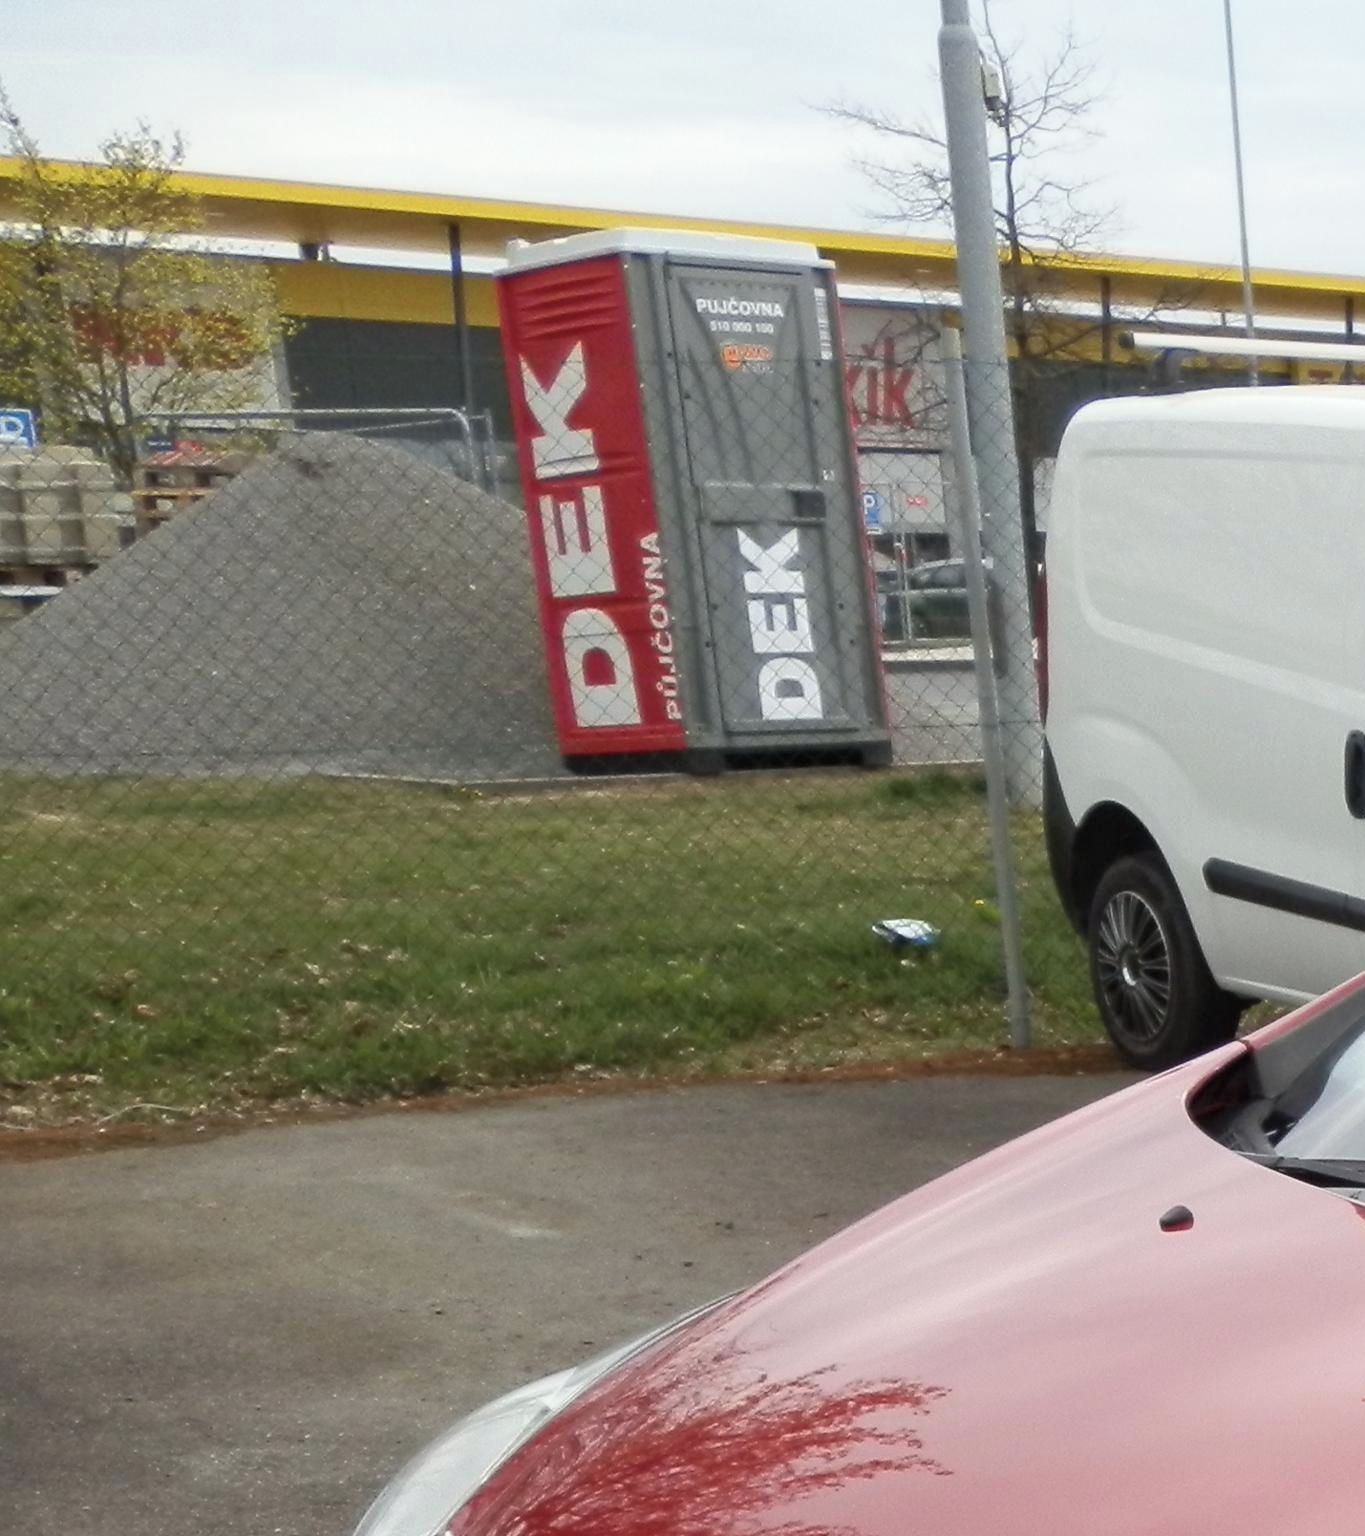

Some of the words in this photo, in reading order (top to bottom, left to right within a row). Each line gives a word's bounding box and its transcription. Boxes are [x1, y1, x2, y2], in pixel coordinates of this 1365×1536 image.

[519, 340, 641, 727] DEK
[639, 531, 682, 720] PŮJČOVNA
[736, 527, 824, 721] DEK
